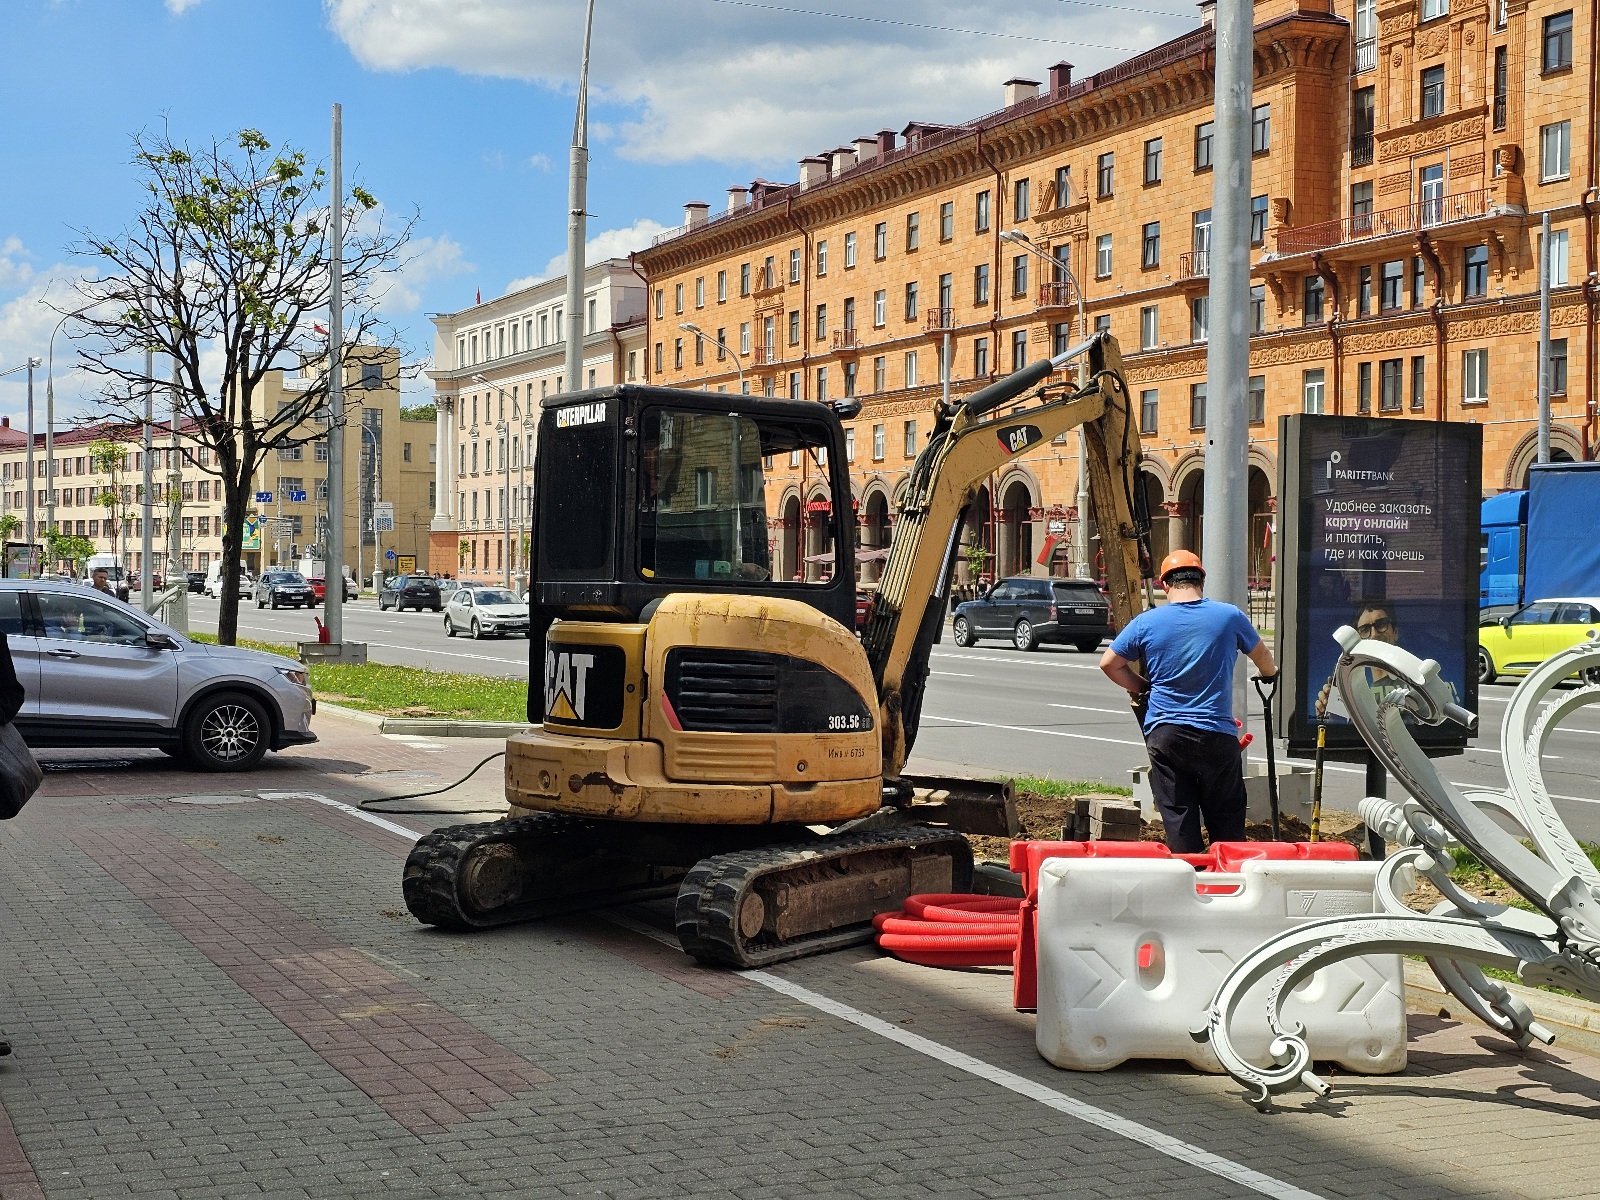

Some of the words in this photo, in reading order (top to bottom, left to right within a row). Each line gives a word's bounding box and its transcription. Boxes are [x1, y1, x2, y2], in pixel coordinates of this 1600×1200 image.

[556, 402, 606, 428] CATERPILLAR
[1009, 426, 1028, 452] CAT
[1335, 469, 1395, 481] PARITETBANK
[1325, 498, 1377, 514] Удобнее
[1379, 503, 1432, 515] заказать
[1325, 517, 1361, 531] карту
[1363, 516, 1409, 530] онлайн
[1325, 533, 1333, 543] и
[1336, 533, 1386, 547] платить,
[1324, 548, 1345, 561] где
[1348, 549, 1355, 559] и
[1358, 549, 1379, 560] как
[1381, 550, 1425, 561] хочешь
[544, 649, 595, 720] CAT
[828, 714, 860, 730] 303.5C
